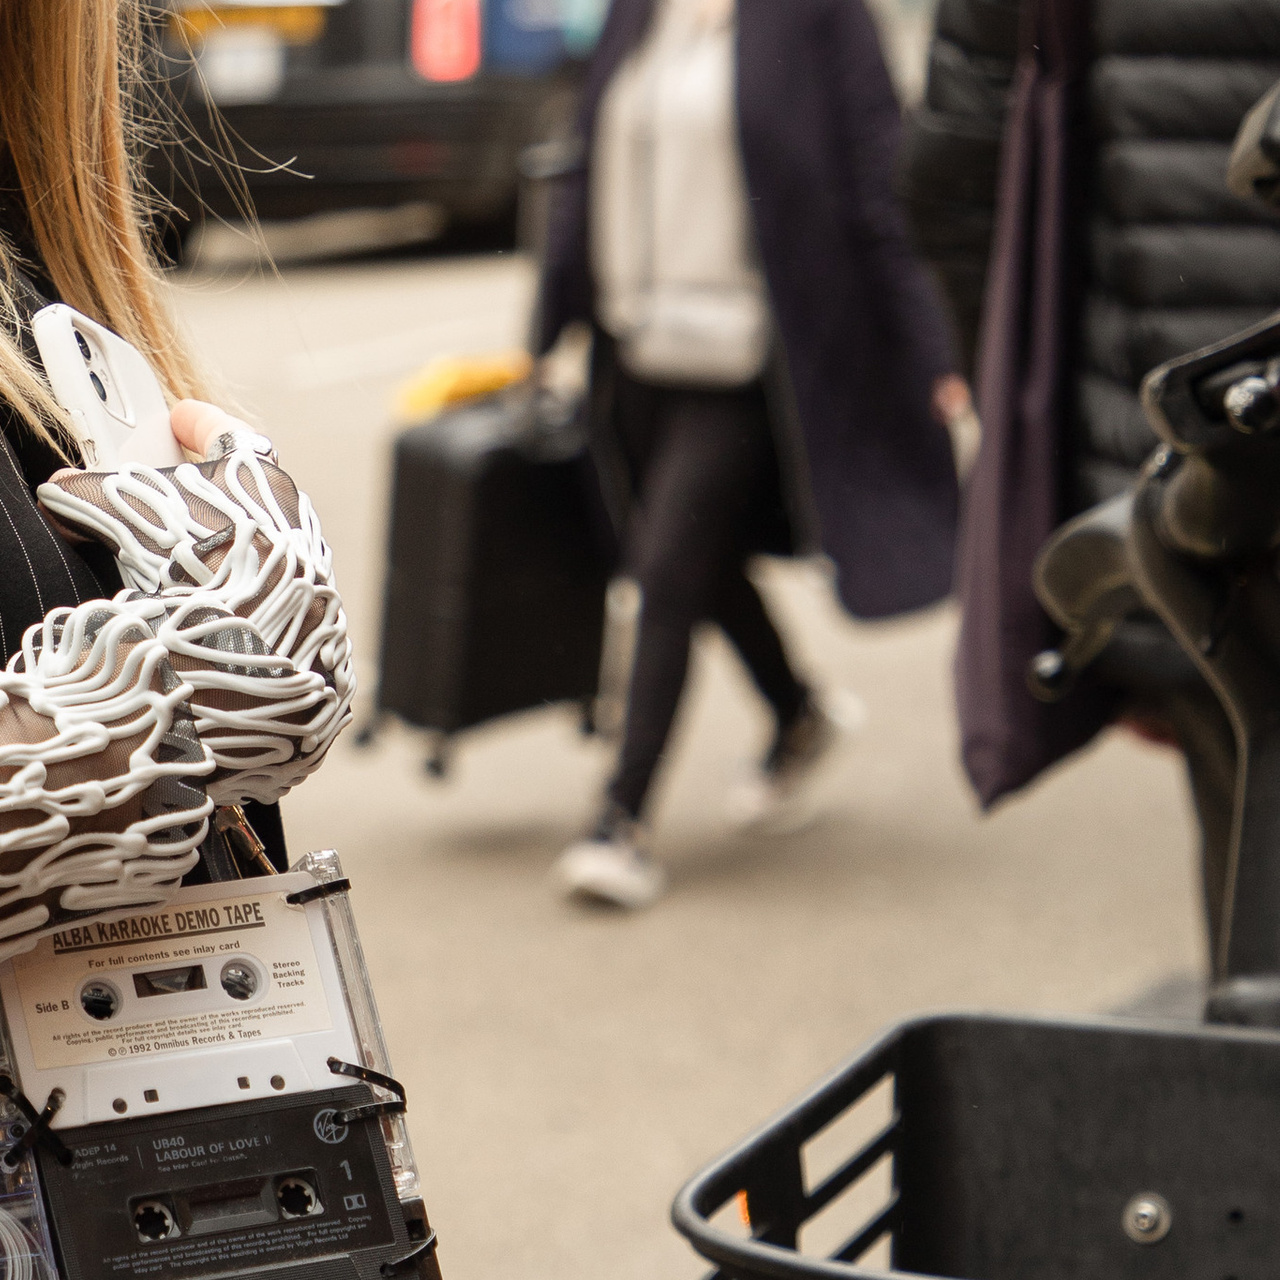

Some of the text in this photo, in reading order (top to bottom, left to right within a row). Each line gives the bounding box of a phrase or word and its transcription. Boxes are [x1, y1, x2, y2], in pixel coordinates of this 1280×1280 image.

[53, 900, 264, 949] ALBA KARAOKE DEMO TAPE
[88, 939, 240, 968] For full contents see inlay card
[273, 959, 300, 970] Stereo
[273, 968, 304, 982] Backing
[277, 978, 304, 989] Tracks
[35, 999, 70, 1014] Side B
[129, 1028, 262, 1054] 1992 Omnibus Records & Tapes
[104, 1142, 117, 1153] 14
[152, 1135, 185, 1150] UB40
[155, 1135, 261, 1162] LABOUR OF LOVE
[96, 1154, 128, 1166] Records
[339, 1160, 354, 1181] 1
